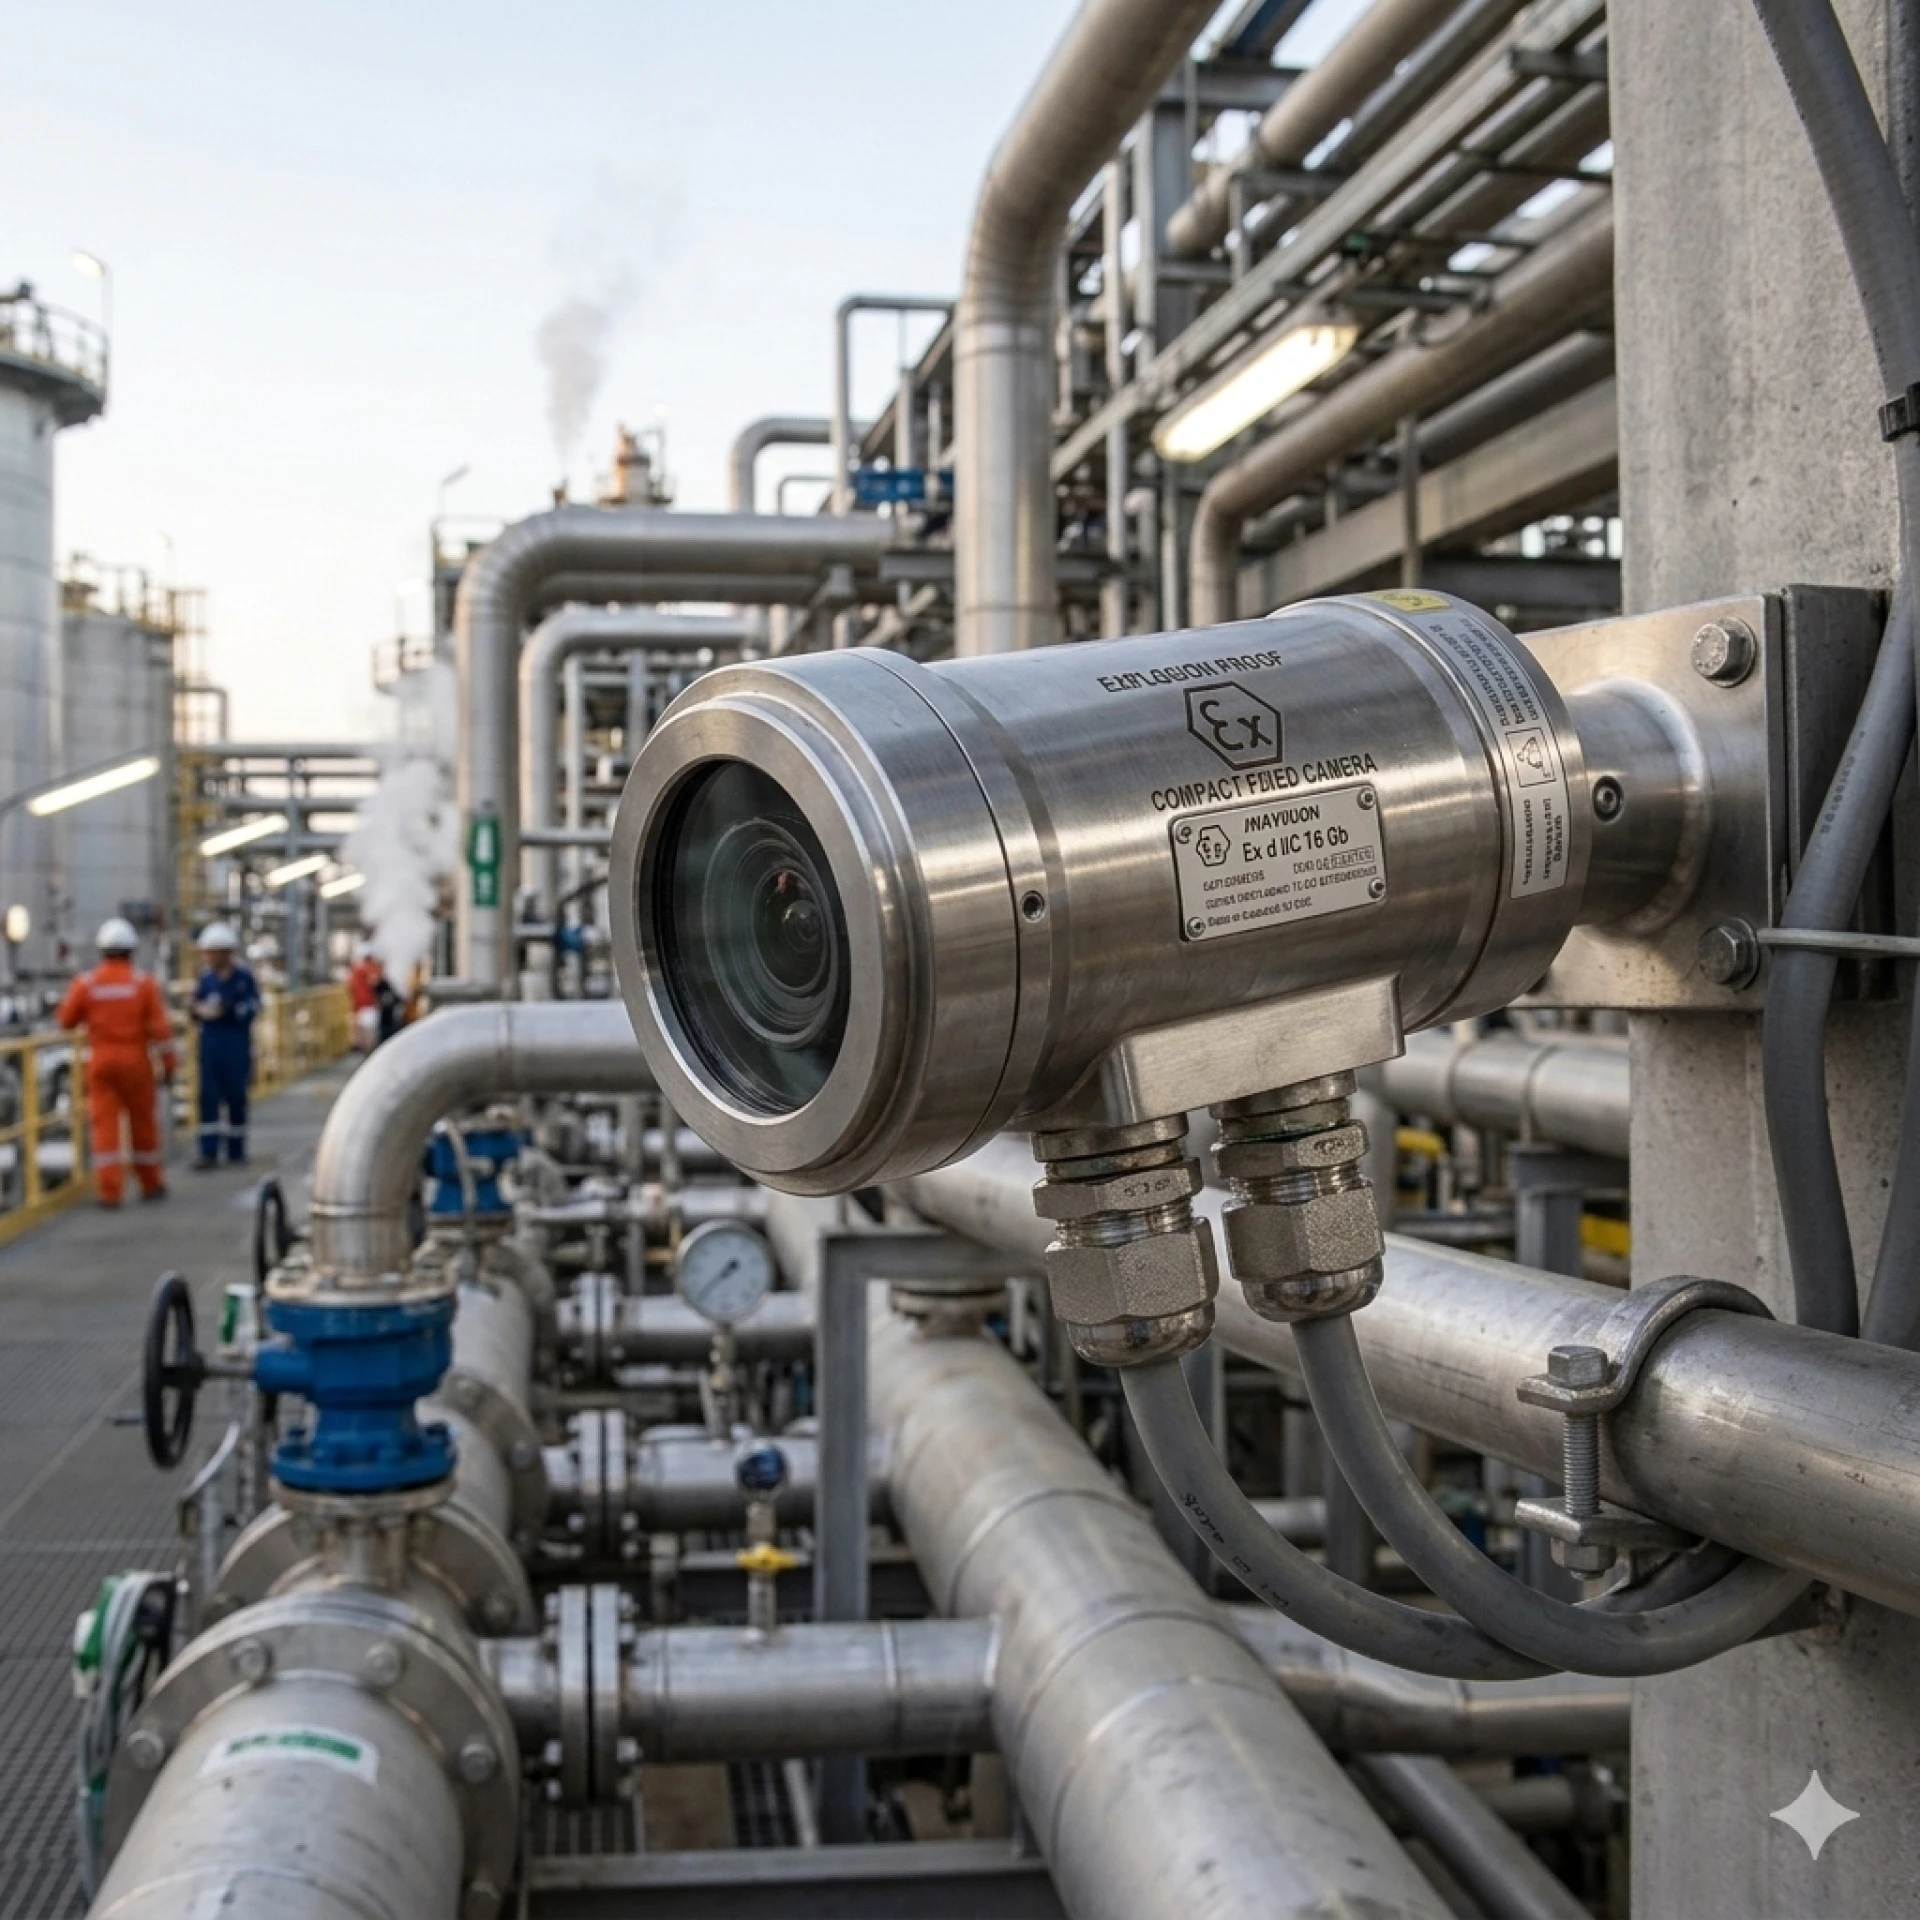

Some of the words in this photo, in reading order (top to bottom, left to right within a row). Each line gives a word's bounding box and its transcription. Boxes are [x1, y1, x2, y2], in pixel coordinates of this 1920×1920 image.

[1151, 775, 1242, 812] COMPACT
[1303, 753, 1379, 783] CAMERA
[1242, 842, 1263, 862] Ex
[1266, 838, 1277, 858] d
[1327, 826, 1349, 846] Gb
